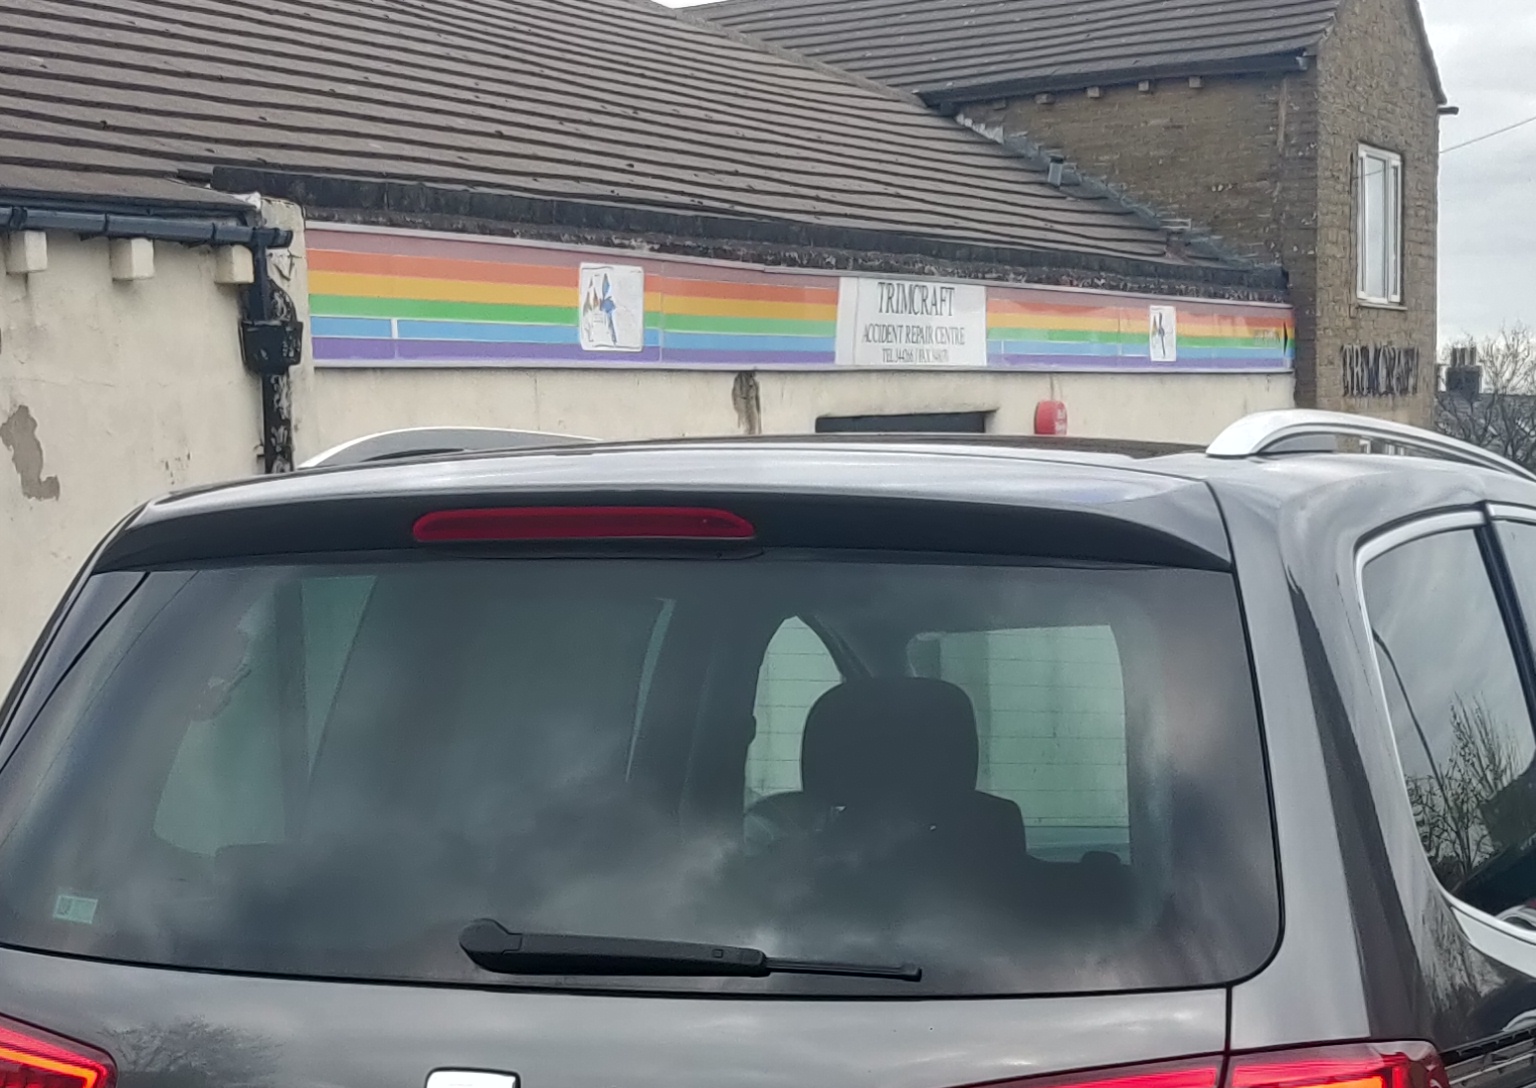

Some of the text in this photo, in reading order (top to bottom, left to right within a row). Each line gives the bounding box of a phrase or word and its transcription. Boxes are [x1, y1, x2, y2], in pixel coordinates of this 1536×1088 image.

[877, 281, 955, 316] TRIMCRAFT
[862, 323, 965, 345] ACCIDENT REPAIR CENTRE
